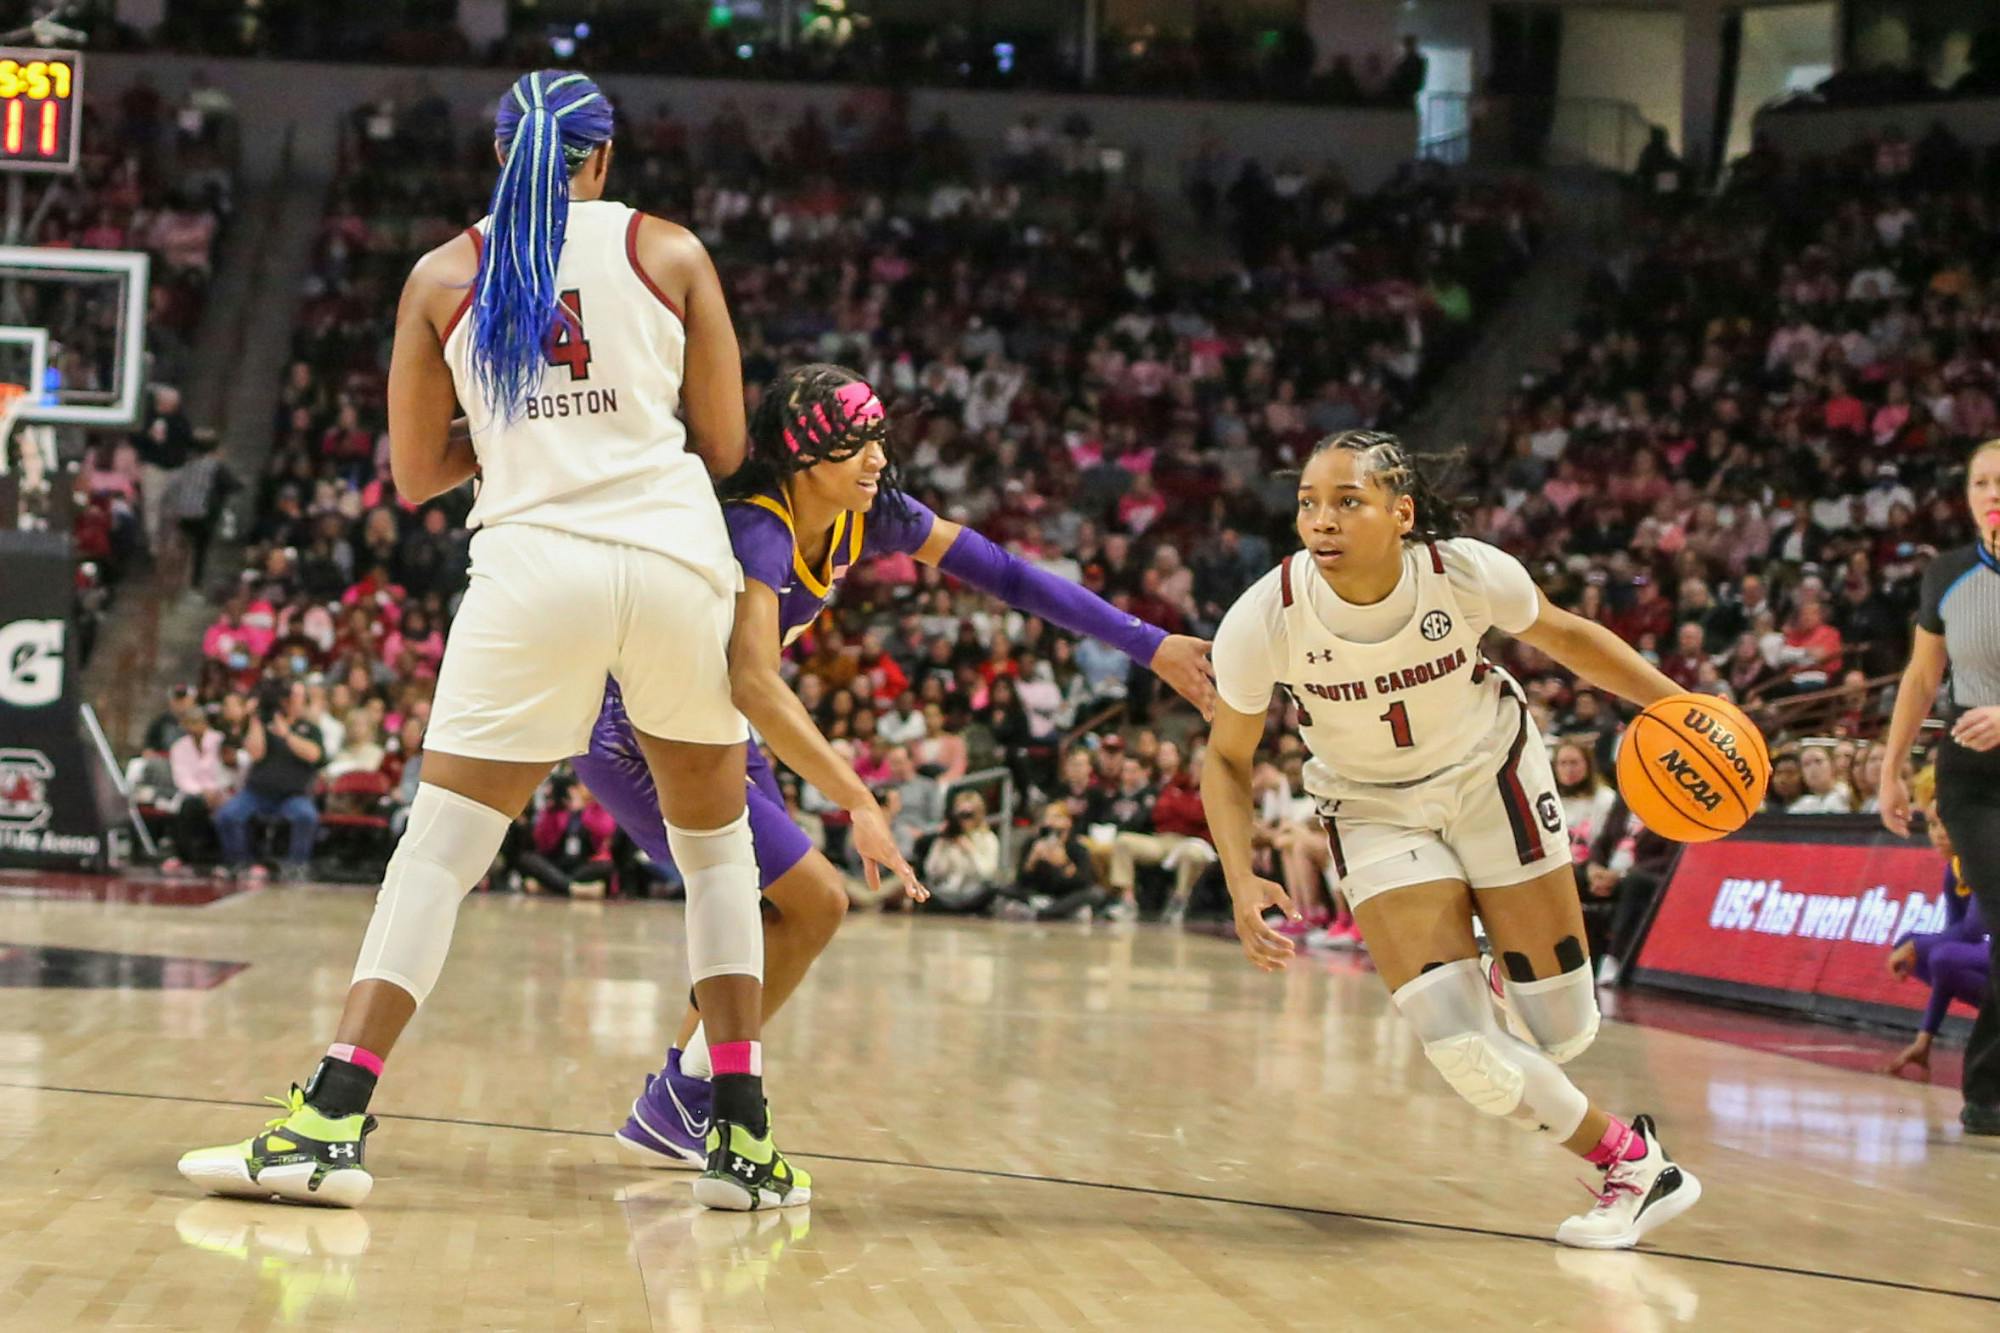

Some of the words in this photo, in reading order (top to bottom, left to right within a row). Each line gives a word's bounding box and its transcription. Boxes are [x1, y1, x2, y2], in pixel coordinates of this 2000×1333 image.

[5, 98, 58, 156] 11
[541, 288, 591, 381] 4
[527, 389, 617, 419] BOSTON
[1423, 611, 1451, 641] SEC
[0, 619, 65, 707] G
[1304, 681, 1368, 702] SOUTH
[1375, 647, 1467, 694] CAROLINA
[1380, 700, 1414, 748] 1
[1683, 708, 1756, 790] Wilson
[1659, 749, 1724, 811] NCAA
[1709, 878, 1767, 930] USC
[1754, 880, 1804, 936] has
[1797, 894, 1857, 940] won
[1851, 885, 1899, 945] the
